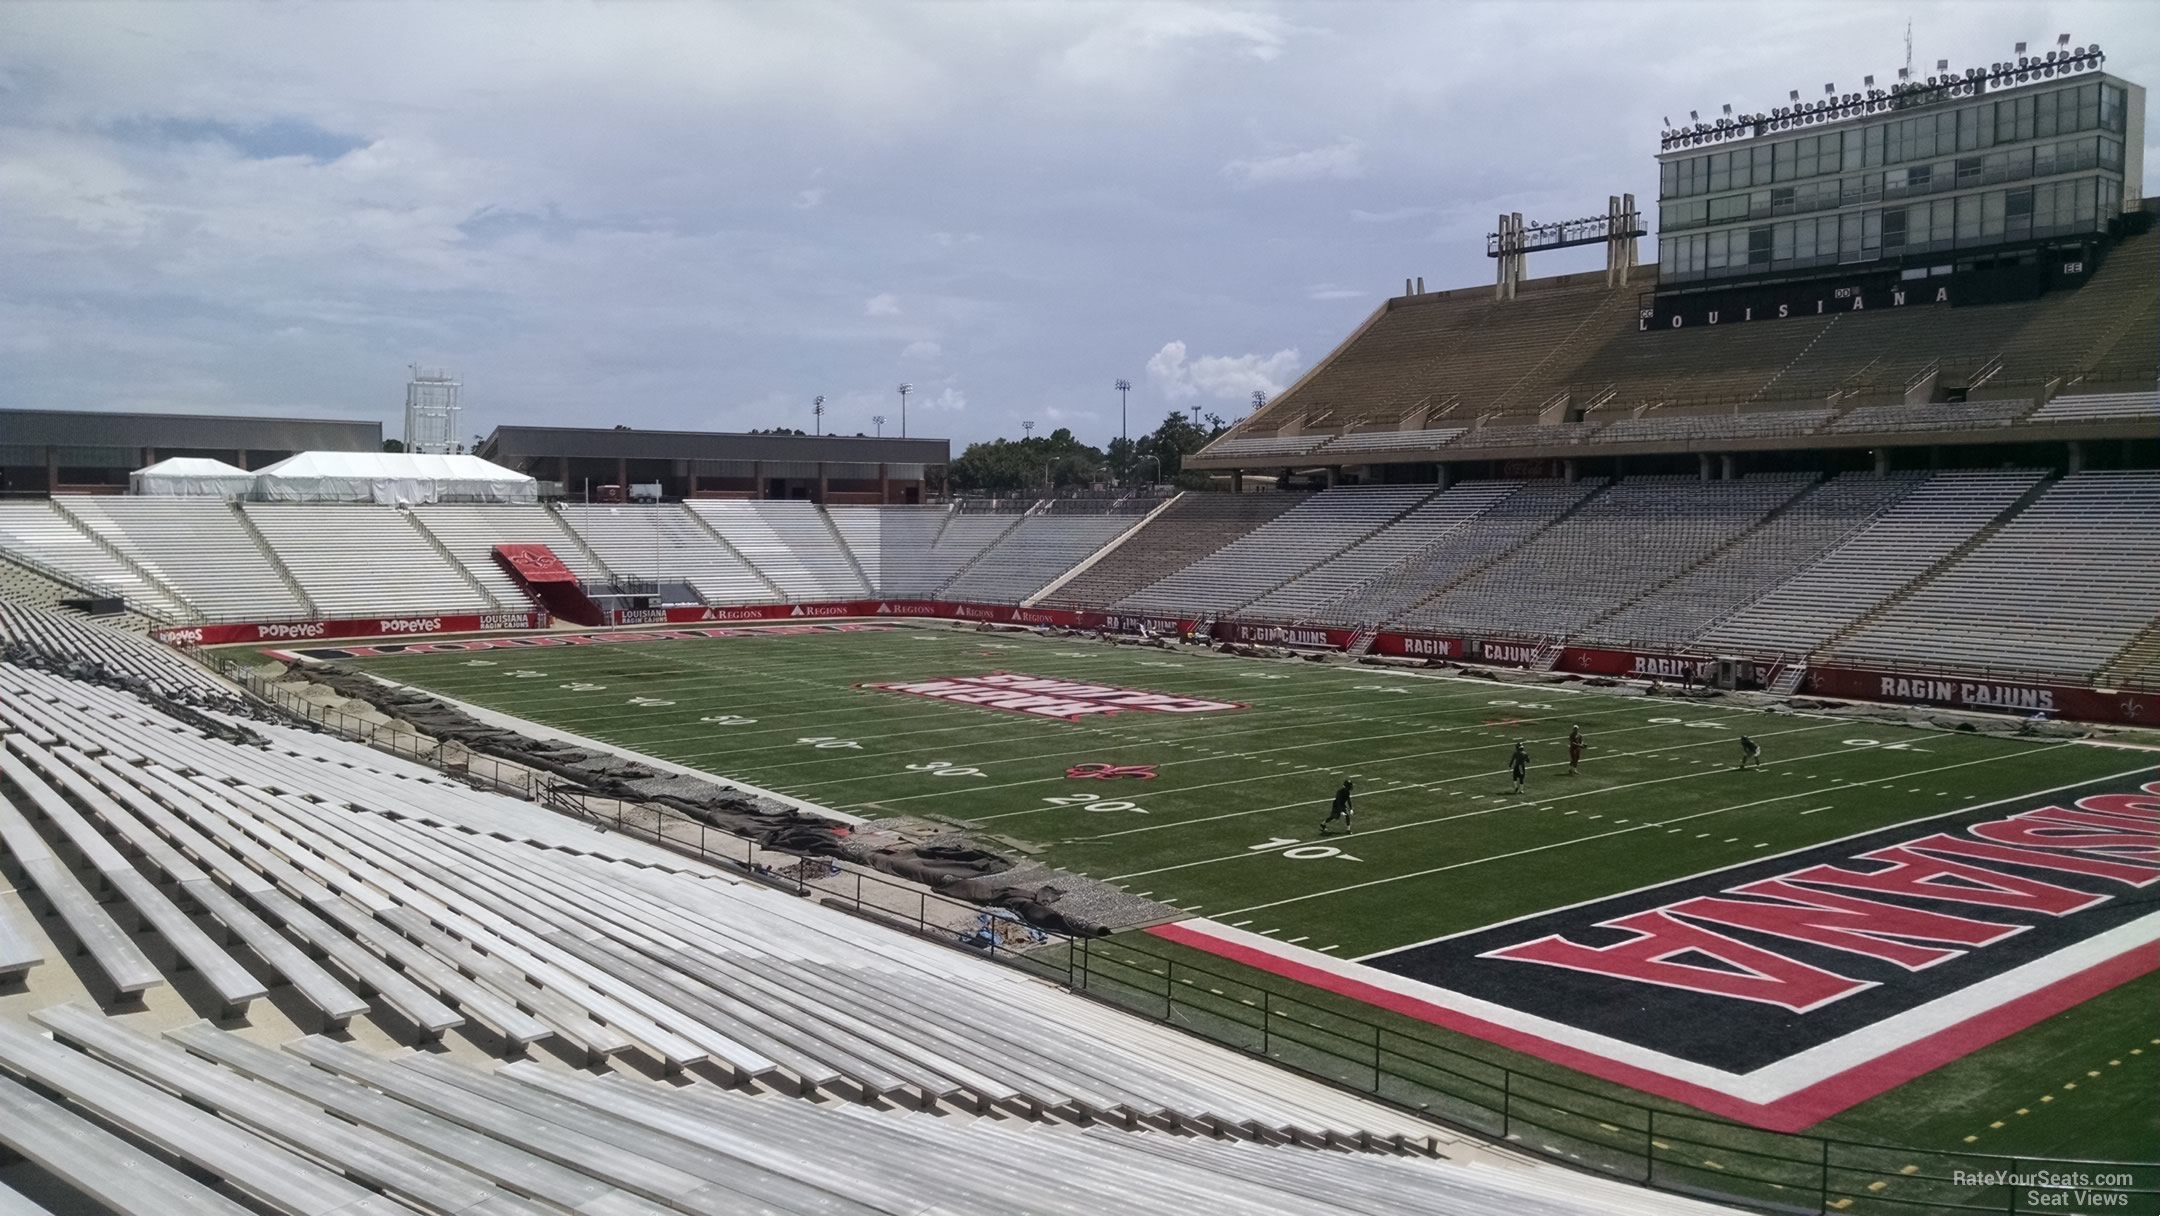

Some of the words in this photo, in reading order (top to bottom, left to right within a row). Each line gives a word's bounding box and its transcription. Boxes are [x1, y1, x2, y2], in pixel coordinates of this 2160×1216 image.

[622, 610, 666, 618] LOUISIANA
[719, 609, 762, 619] REGIONS
[807, 606, 847, 616] REGIONS
[480, 614, 528, 623] LOUISIANA
[1961, 683, 2054, 709] CAJUNS
[905, 762, 979, 776] 30
[1042, 794, 1136, 812] 20
[1248, 837, 1342, 859] 10
